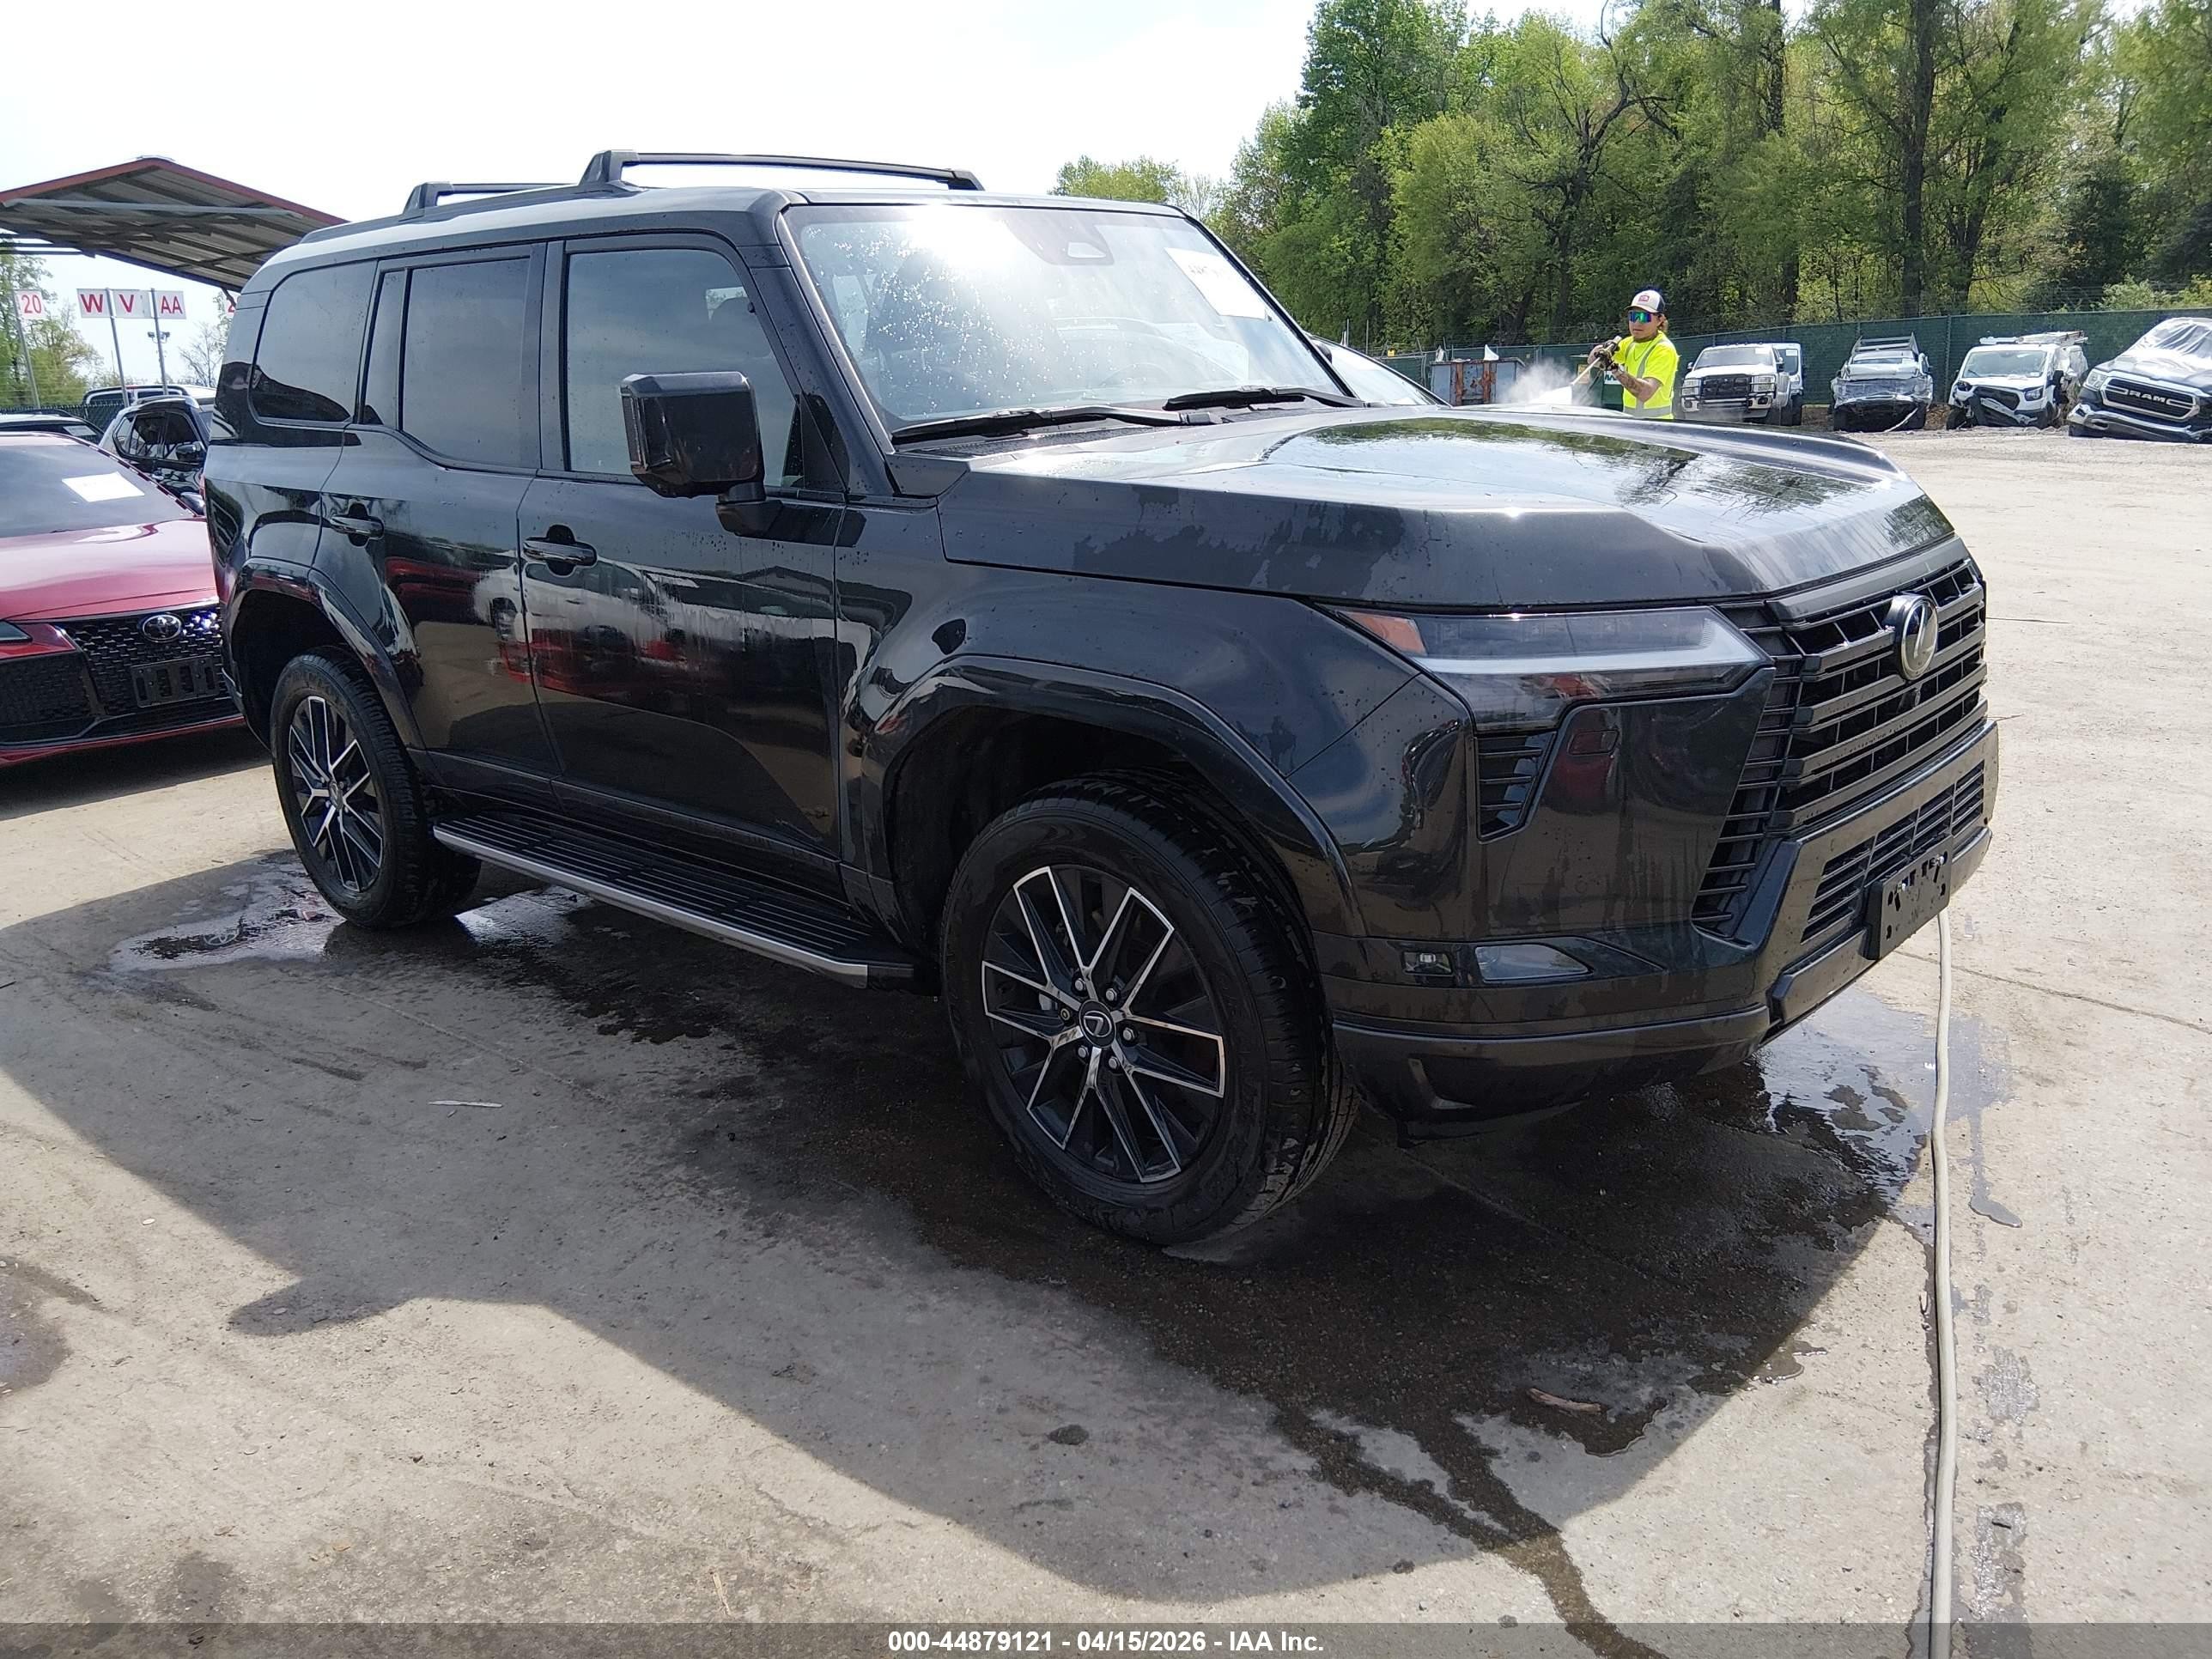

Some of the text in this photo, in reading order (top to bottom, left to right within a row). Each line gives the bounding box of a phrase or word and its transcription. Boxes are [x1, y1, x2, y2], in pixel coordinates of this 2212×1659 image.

[21, 295, 42, 314] 20
[81, 294, 183, 314] W V AA
[2130, 390, 2166, 403] RAM
